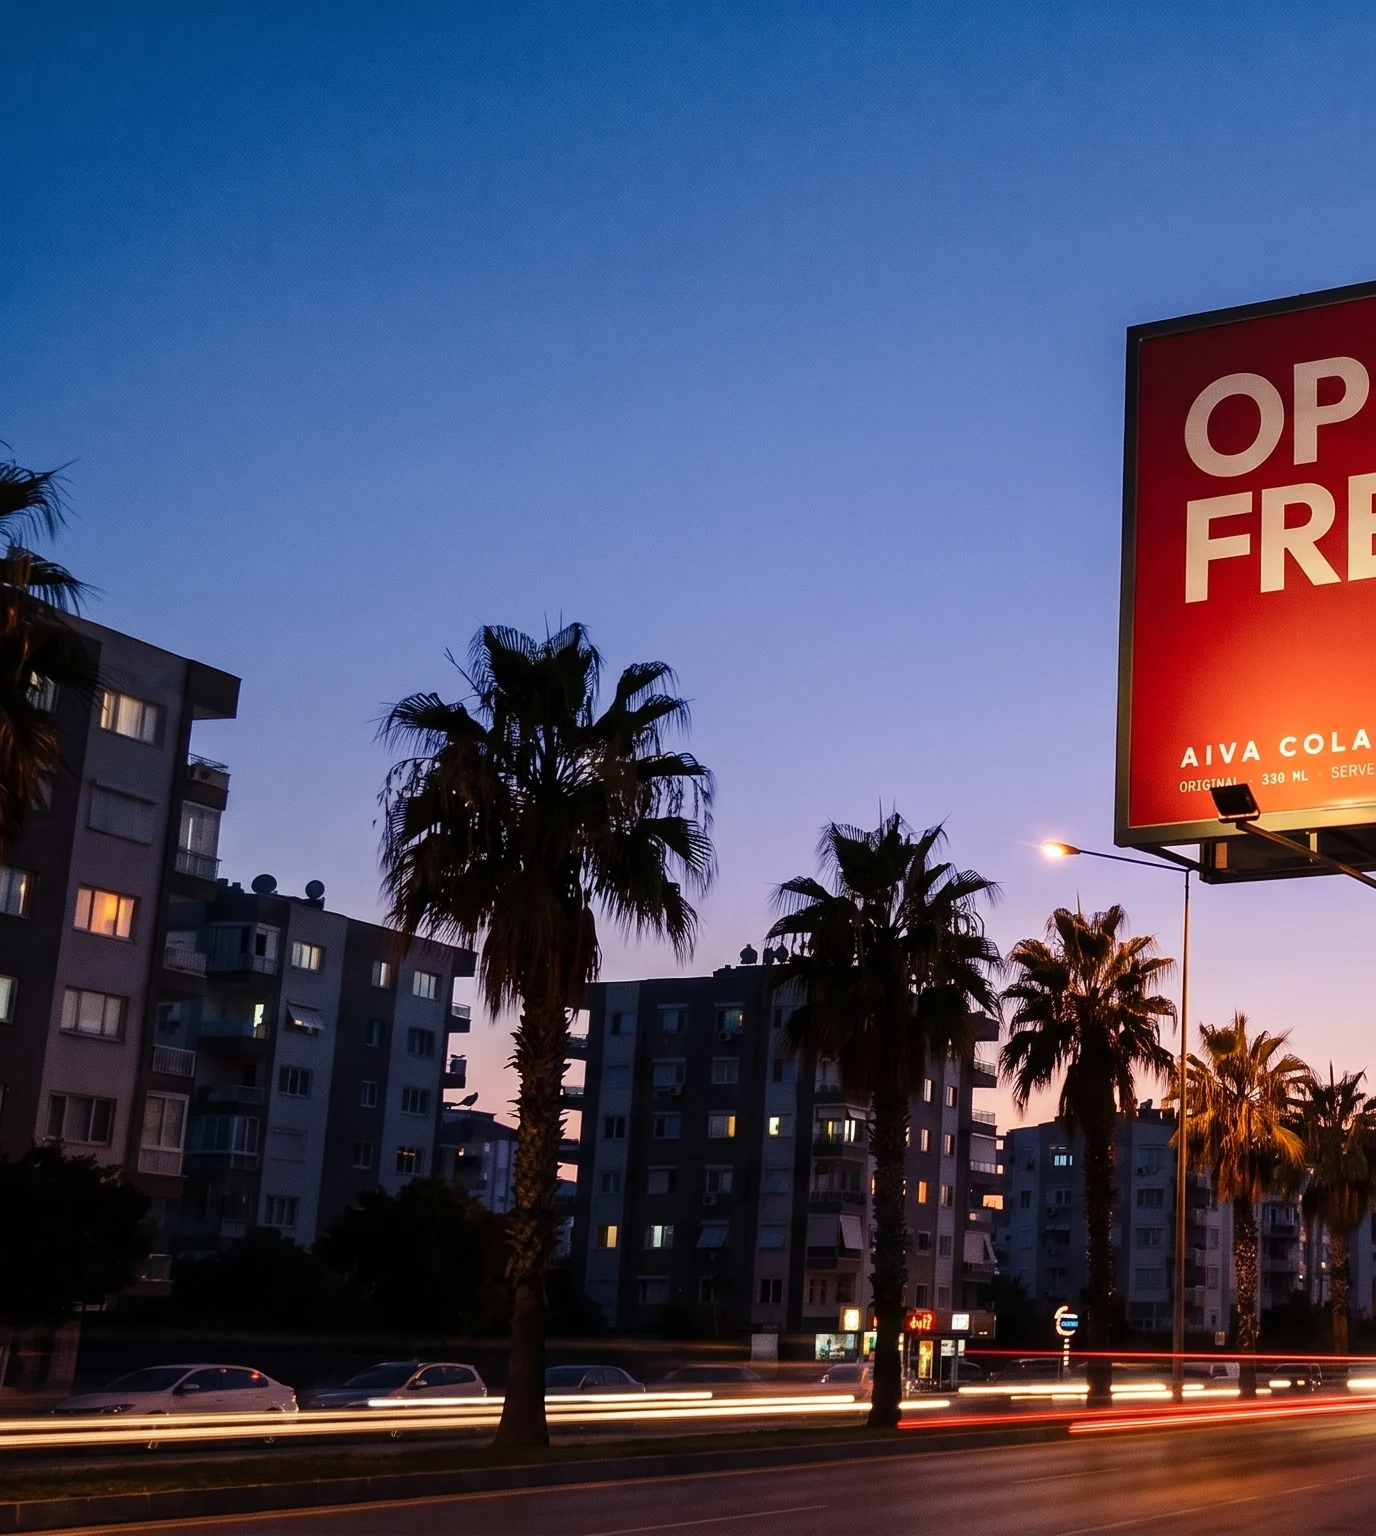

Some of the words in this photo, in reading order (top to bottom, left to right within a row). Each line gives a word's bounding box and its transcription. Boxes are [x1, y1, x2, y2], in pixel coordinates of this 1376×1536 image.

[1180, 740, 1260, 768] AIVA
[1279, 728, 1372, 757] COLA
[1261, 772, 1285, 786] 330
[1292, 770, 1309, 783] ML
[1330, 762, 1375, 779] SERVE
